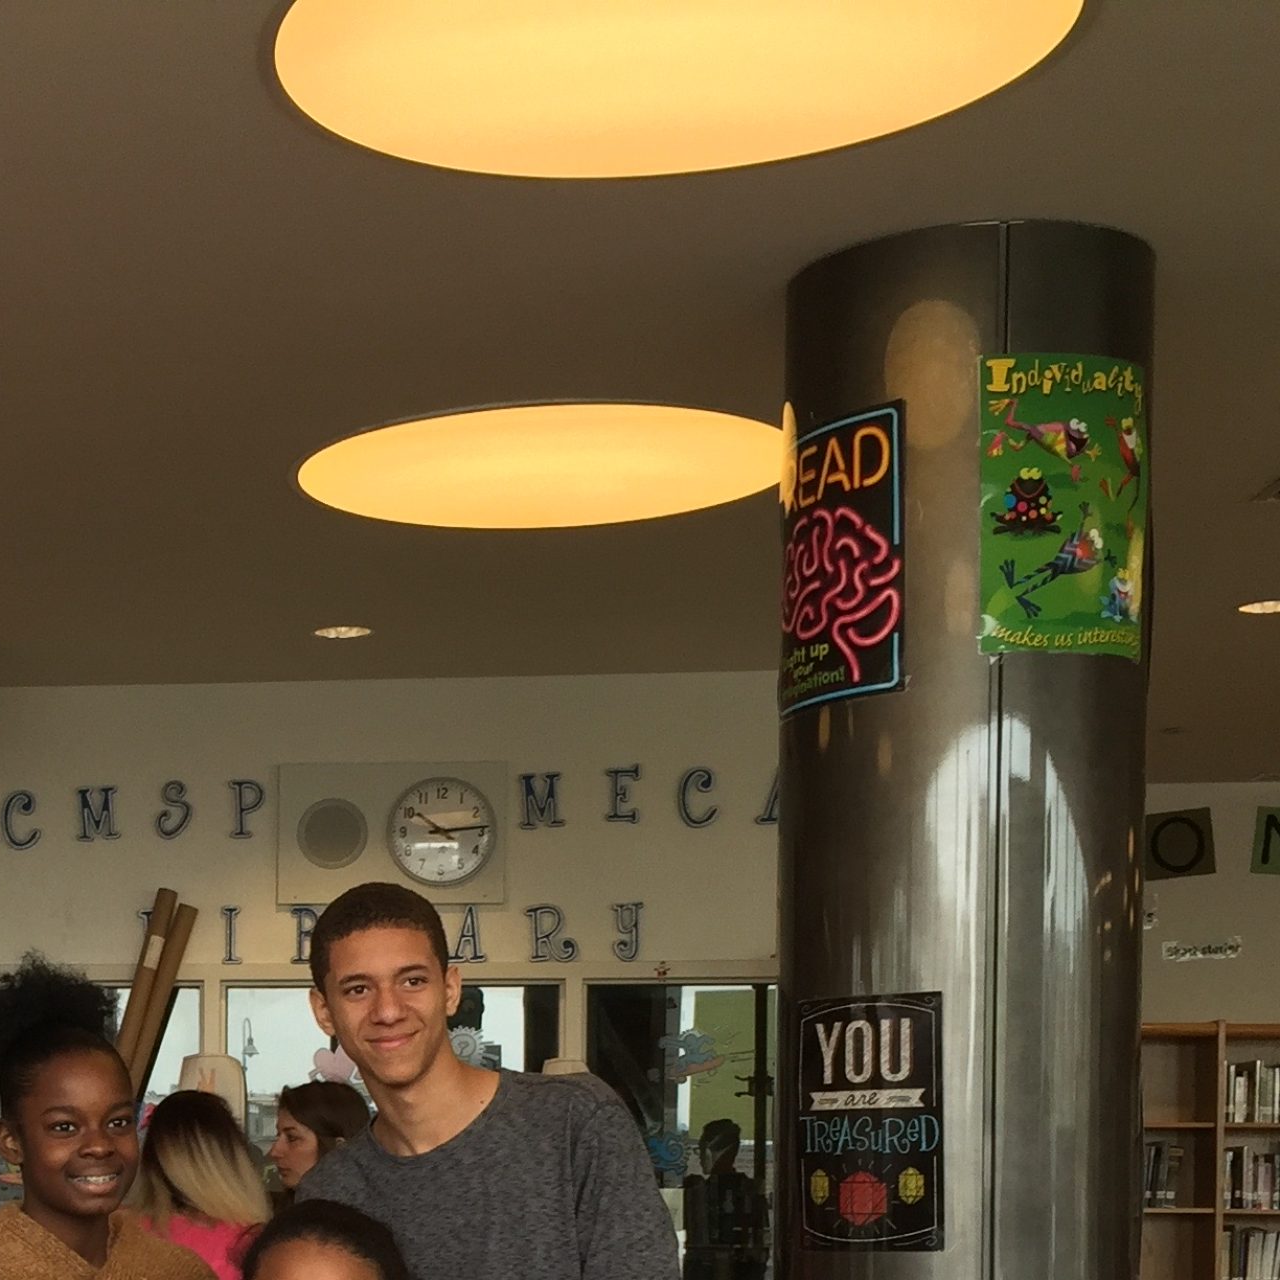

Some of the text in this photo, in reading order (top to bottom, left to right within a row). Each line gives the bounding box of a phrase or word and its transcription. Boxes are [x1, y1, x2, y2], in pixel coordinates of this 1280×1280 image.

[810, 643, 829, 660] up
[991, 624, 1050, 648] makes
[1053, 629, 1074, 647] us
[1, 778, 266, 849] CMSP
[138, 899, 645, 964] IBARY
[815, 1017, 914, 1085] YOU
[845, 1091, 880, 1107] are
